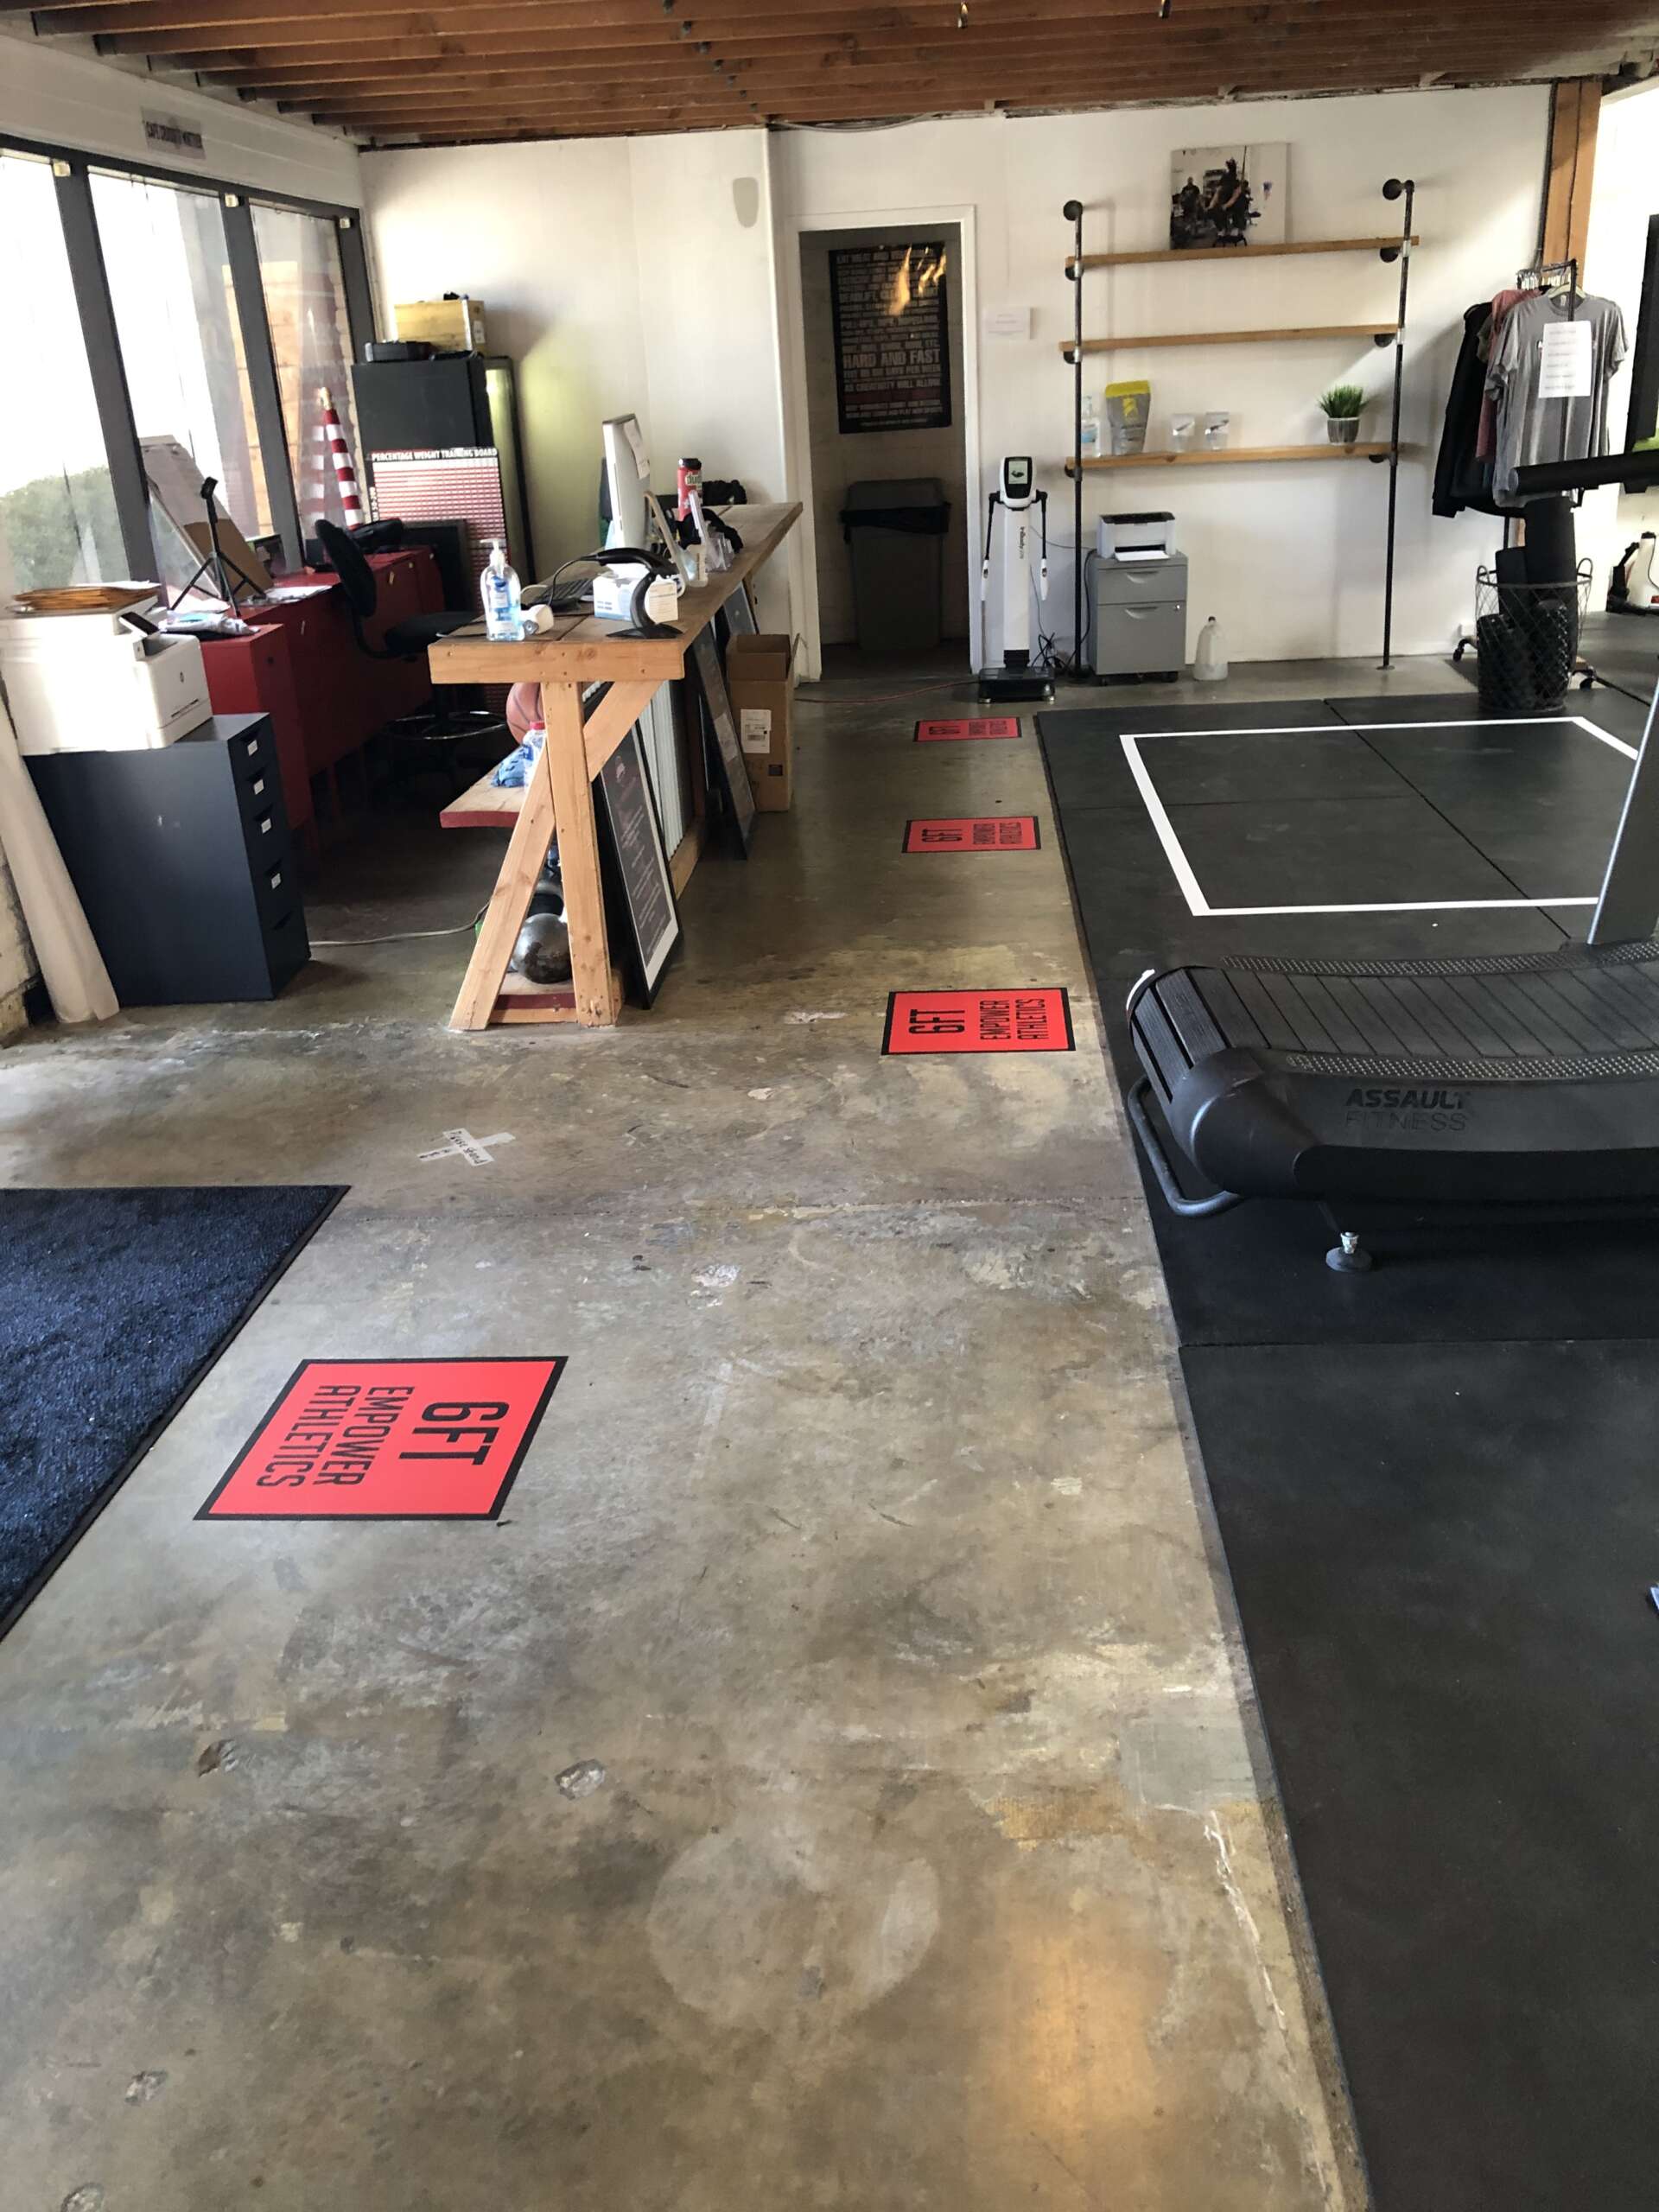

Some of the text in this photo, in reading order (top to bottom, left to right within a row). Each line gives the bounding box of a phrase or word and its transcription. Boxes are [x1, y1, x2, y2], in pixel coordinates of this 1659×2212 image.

[844, 349, 940, 368] HARD AND FAST
[372, 452, 412, 461] PERCENTAGE
[414, 451, 441, 460] WEIGHT
[474, 448, 498, 457] BOARD
[908, 1008, 965, 1034] 6FT
[980, 1000, 1011, 1040] EMPOWER
[1015, 998, 1049, 1040] ATHLETICS
[1345, 1089, 1471, 1109] ASSAULT
[1345, 1111, 1466, 1131] FITNESS
[257, 1385, 361, 1487] ATHLETICS
[313, 1386, 415, 1485] EMPOWER
[399, 1402, 511, 1465] 6FT
